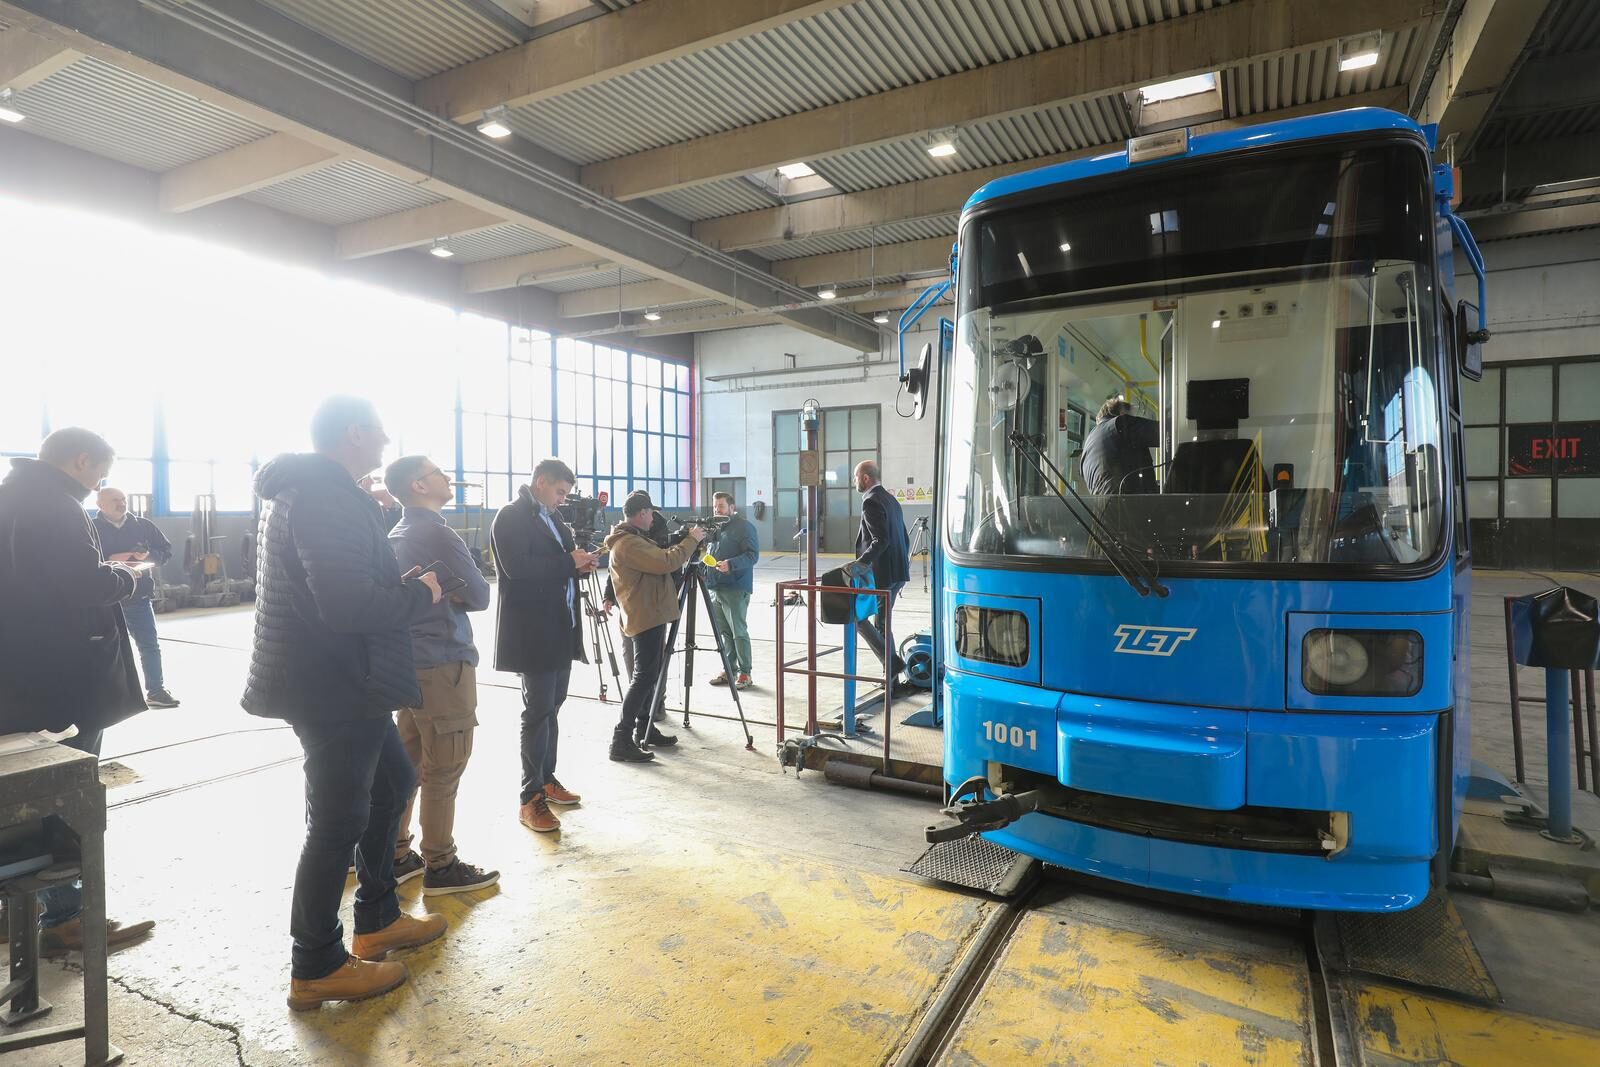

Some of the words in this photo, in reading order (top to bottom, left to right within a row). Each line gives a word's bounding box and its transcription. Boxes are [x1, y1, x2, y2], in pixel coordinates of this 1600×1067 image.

[1531, 438, 1582, 460] EXIT
[1113, 623, 1198, 657] ZET
[982, 720, 1037, 751] 1001
